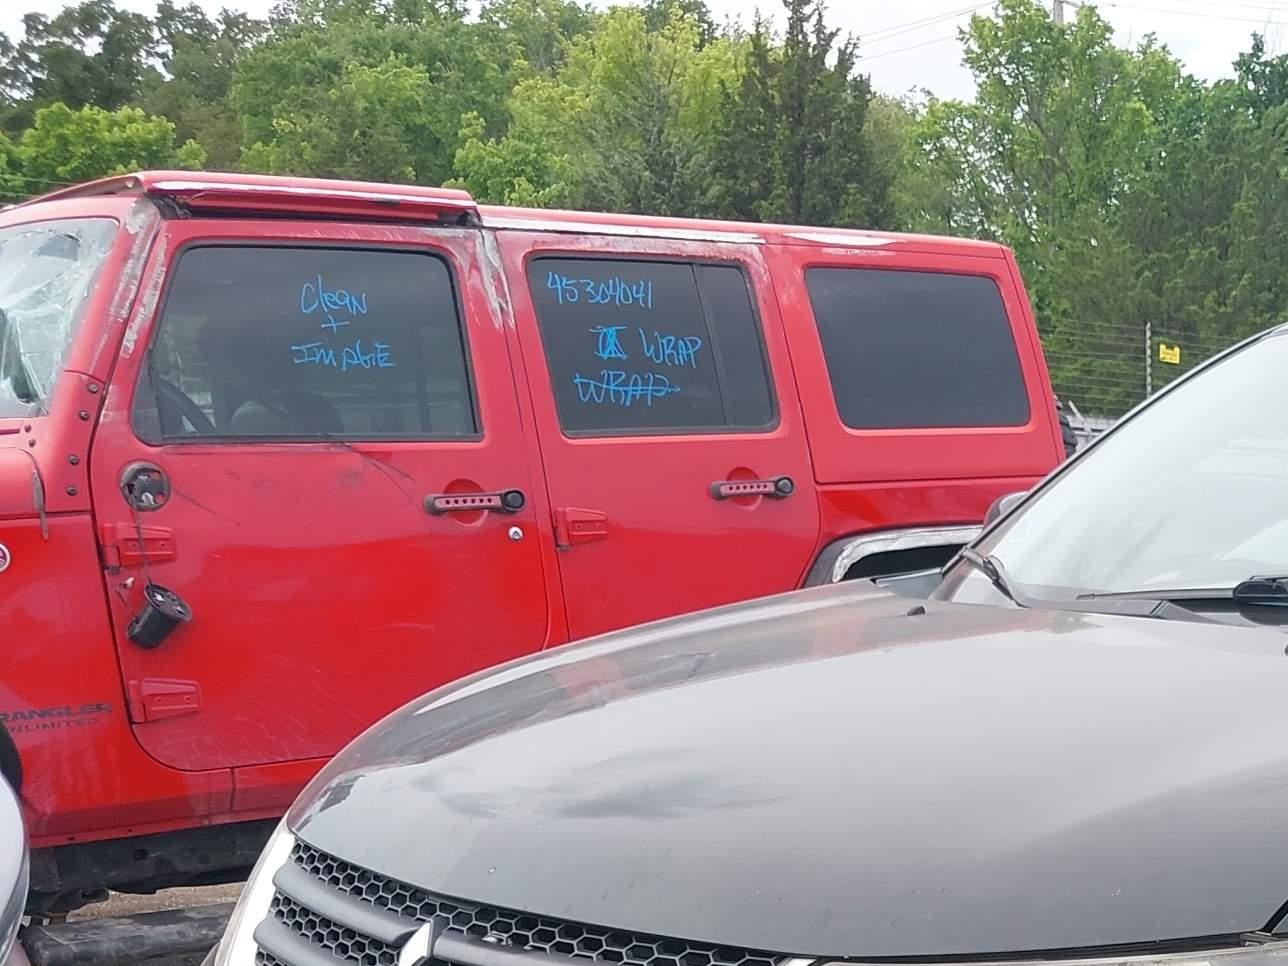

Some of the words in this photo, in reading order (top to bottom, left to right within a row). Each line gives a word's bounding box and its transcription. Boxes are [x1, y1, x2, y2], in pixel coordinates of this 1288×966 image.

[547, 271, 653, 309] 45304041
[638, 327, 702, 369] WRAP
[0, 703, 113, 721] RANGLER
